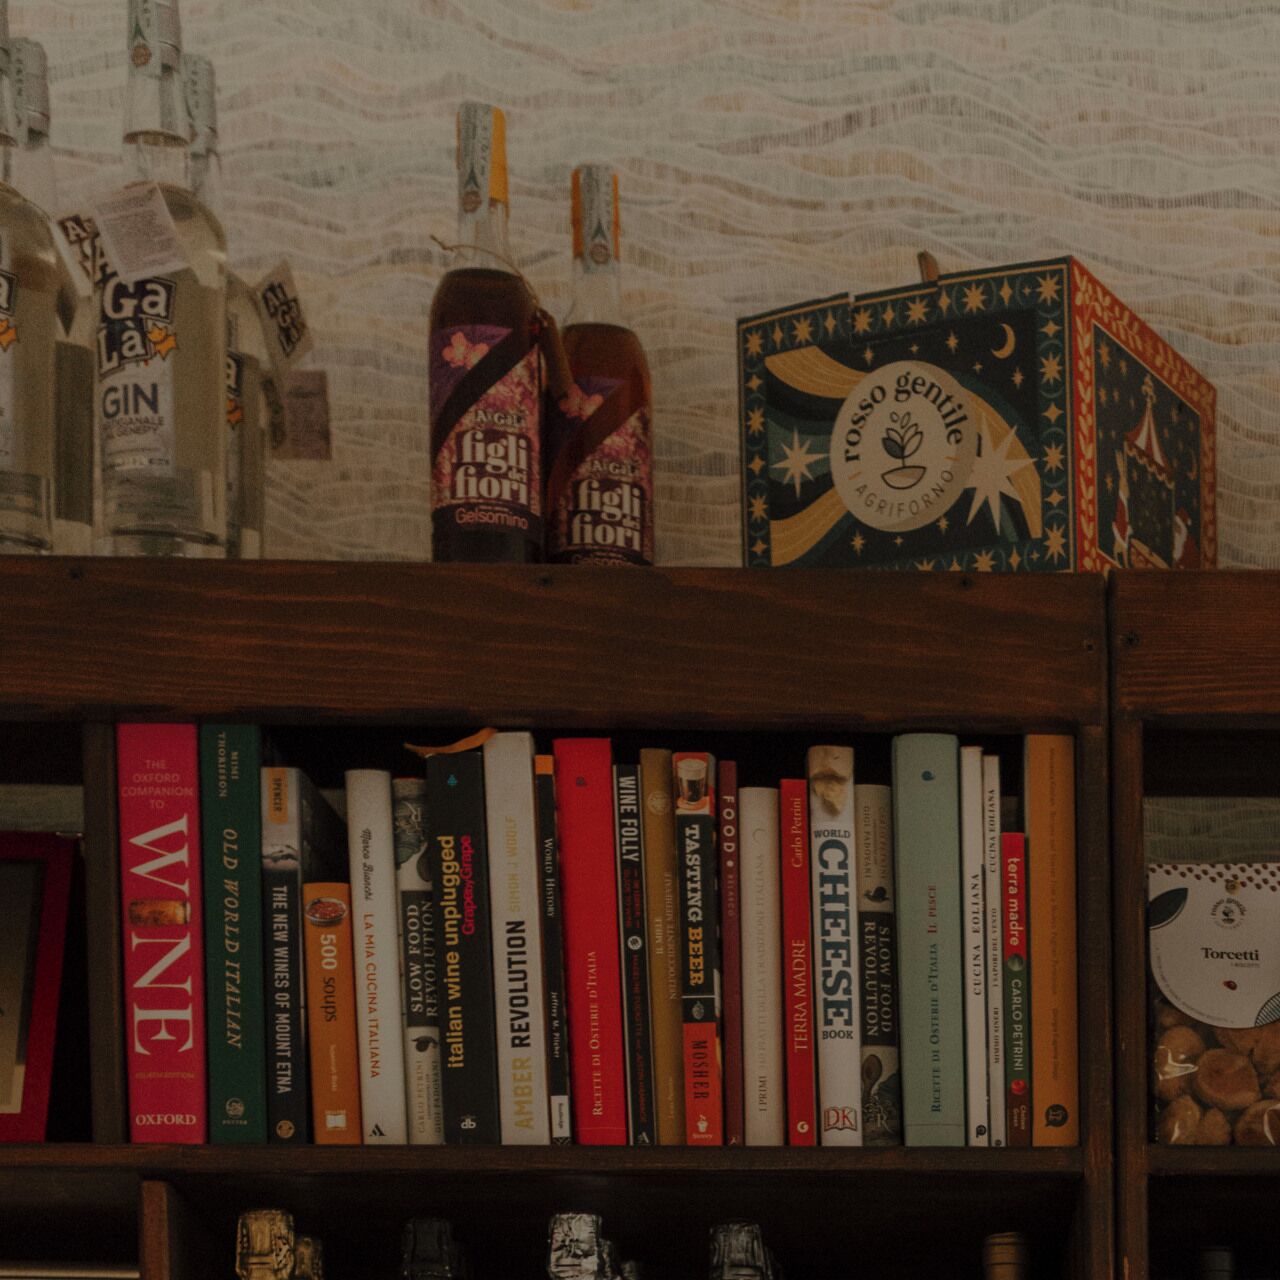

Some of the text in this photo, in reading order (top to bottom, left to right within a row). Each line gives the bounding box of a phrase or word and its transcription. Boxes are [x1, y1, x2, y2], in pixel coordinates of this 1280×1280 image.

[102, 383, 159, 419] GIN
[843, 370, 964, 463] rosso gentile
[462, 430, 528, 475] figli
[454, 463, 528, 506] fiori
[855, 468, 956, 520] AGRIFORNO
[455, 506, 529, 530] Gelsomino
[120, 786, 195, 798] COMPANION
[132, 772, 181, 784] OXFORD
[145, 759, 167, 770] THE
[216, 731, 228, 798] THORISSON
[149, 799, 165, 810] TO
[272, 776, 282, 814] SPENCER
[618, 775, 638, 819] WINE
[720, 795, 736, 853] FOOD
[620, 822, 641, 862] FOLLY
[791, 796, 803, 869] Carlo Petrini
[814, 829, 851, 840] WORLD
[683, 823, 705, 986] TASTING BEER
[817, 838, 854, 1028] CHEESE
[971, 872, 983, 996] CUCINA EOLIANA
[223, 828, 244, 1049] OLD WORLD ITALIAN
[407, 903, 422, 1013] SLOW FOOD
[422, 899, 438, 1018] REVOLUTION
[439, 835, 465, 1070] italian wine unplugged
[1007, 856, 1024, 1072] terra madre CARLO PETRINI
[1201, 947, 1259, 961] Torcetti
[272, 886, 292, 1095] THE NEW WINES OF MOUNT ETNA
[320, 934, 337, 1023] 500 soups
[363, 912, 380, 1079] LA MIA CUCINA ITALIANA
[792, 938, 809, 1054] TERRA MADRE
[506, 919, 533, 1129] AMBER REVOLUTION
[822, 1029, 854, 1041] BOOK
[694, 1039, 709, 1100] MOSHER
[135, 1113, 197, 1127] OXFORD
